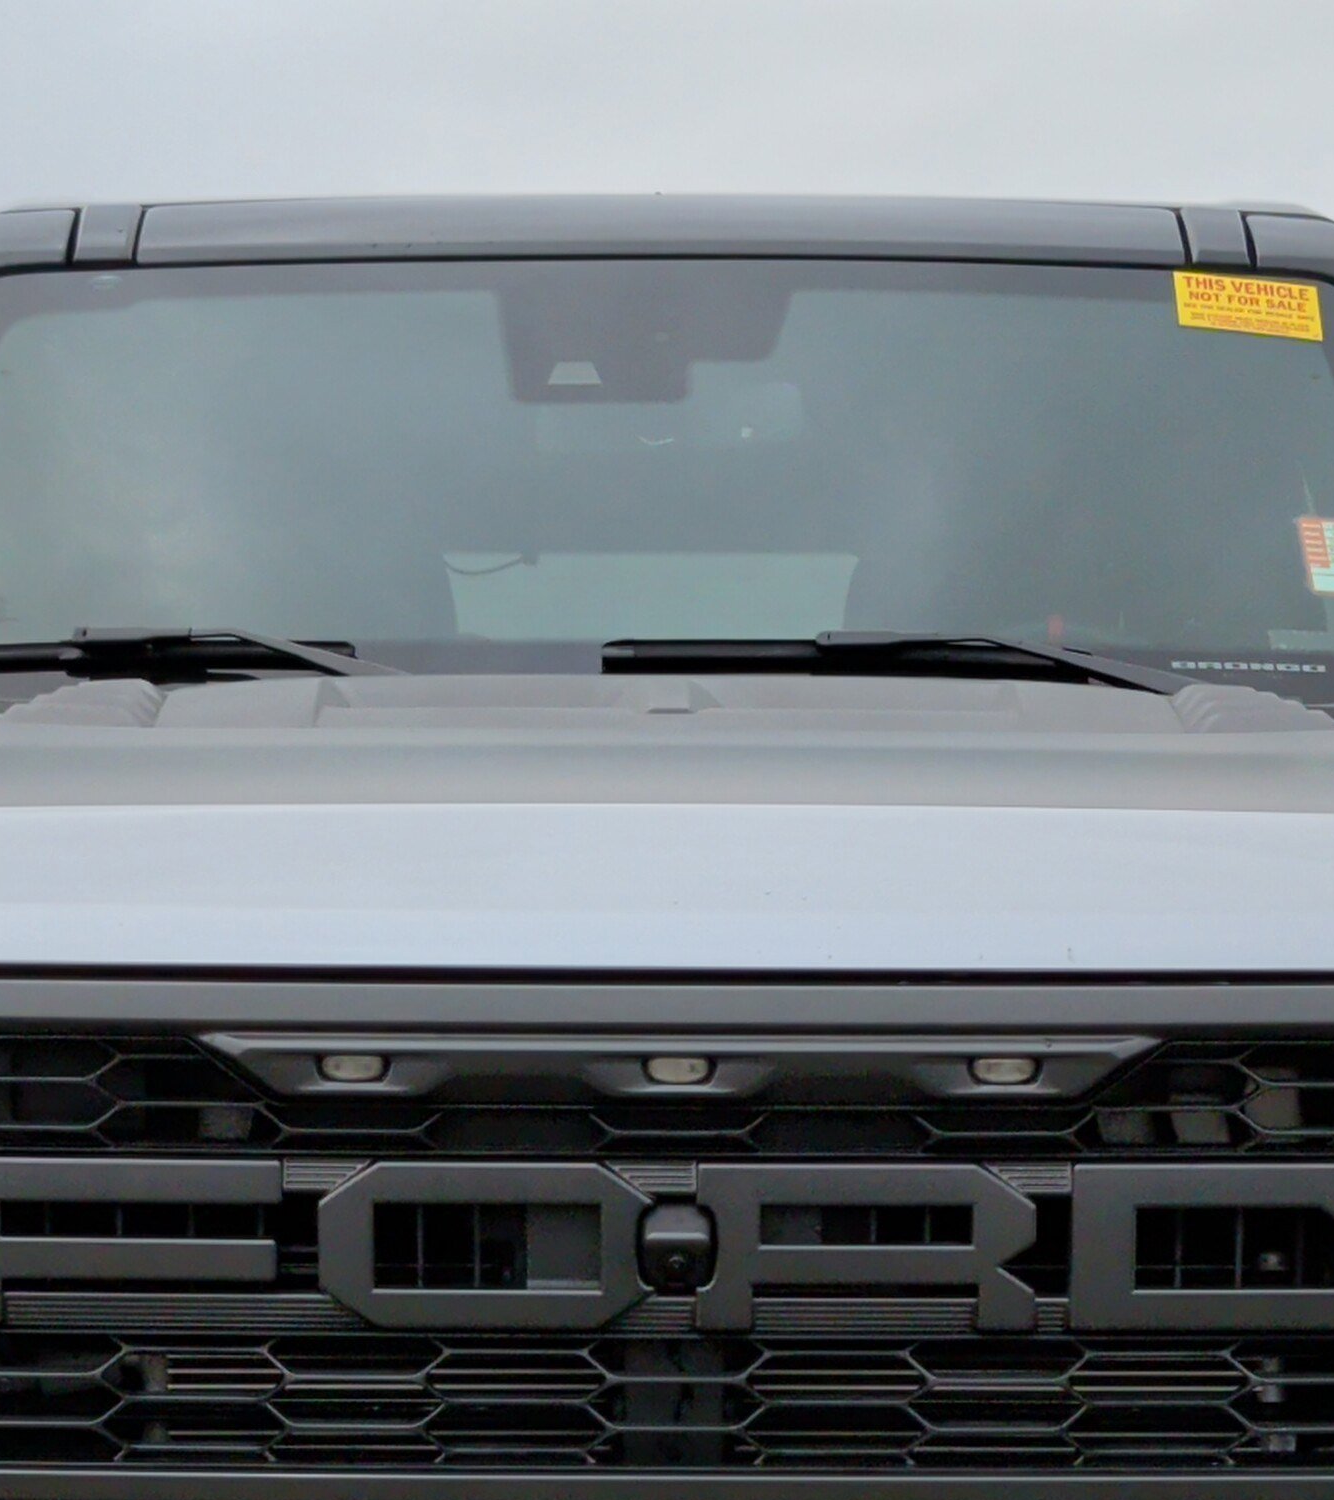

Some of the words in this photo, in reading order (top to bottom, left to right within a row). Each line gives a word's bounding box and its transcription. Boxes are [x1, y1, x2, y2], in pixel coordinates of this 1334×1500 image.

[1182, 276, 1226, 290] THIS
[1231, 280, 1309, 301] VEHICLE
[1188, 291, 1221, 303] NOT
[1227, 295, 1260, 307] FOR
[1266, 299, 1307, 312] SALE
[1171, 661, 1326, 673] BRONCO
